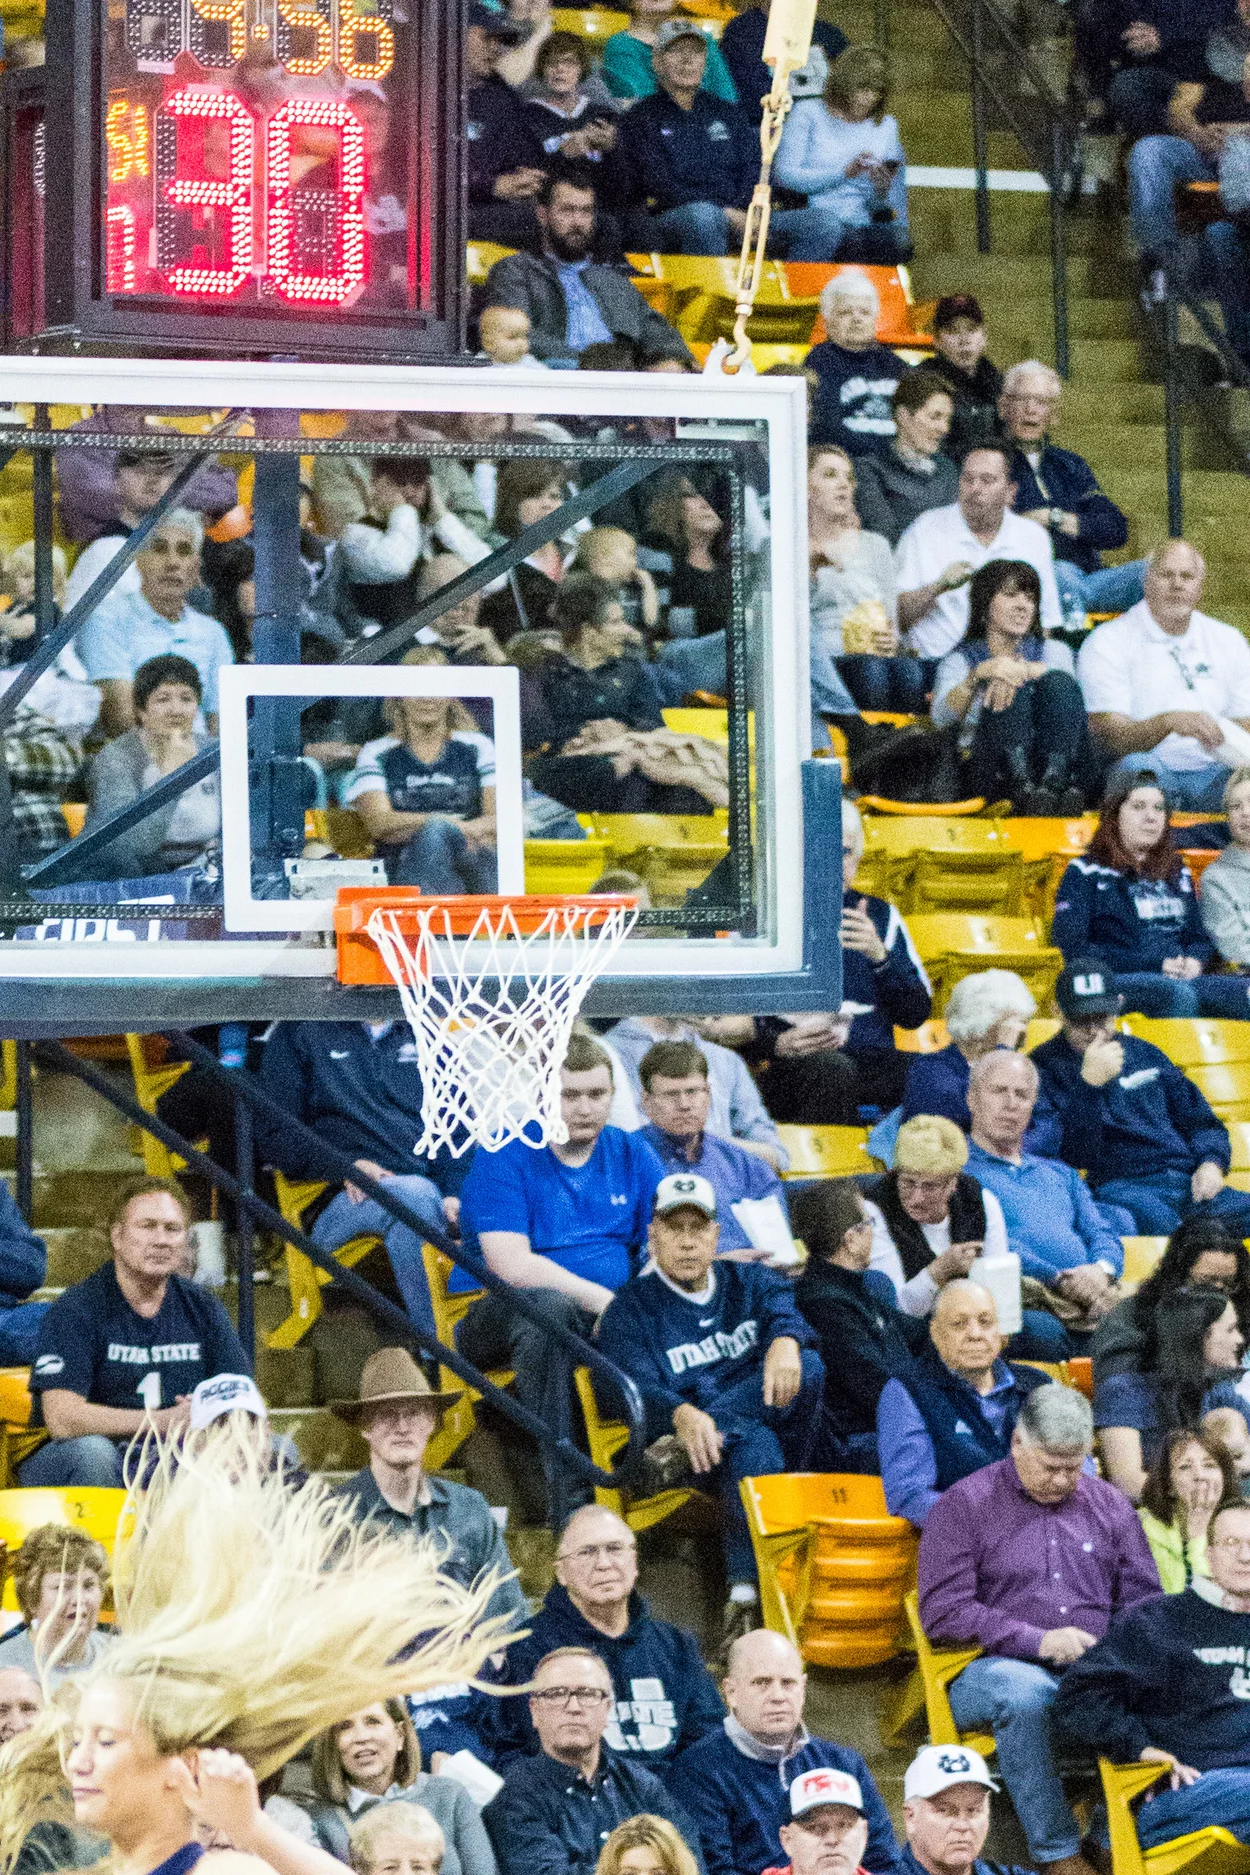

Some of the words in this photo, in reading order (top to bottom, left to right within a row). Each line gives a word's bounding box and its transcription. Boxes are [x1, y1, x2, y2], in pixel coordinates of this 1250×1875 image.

[167, 90, 365, 302] 30
[107, 1342, 150, 1365] UTAH
[151, 1342, 202, 1363] STATE
